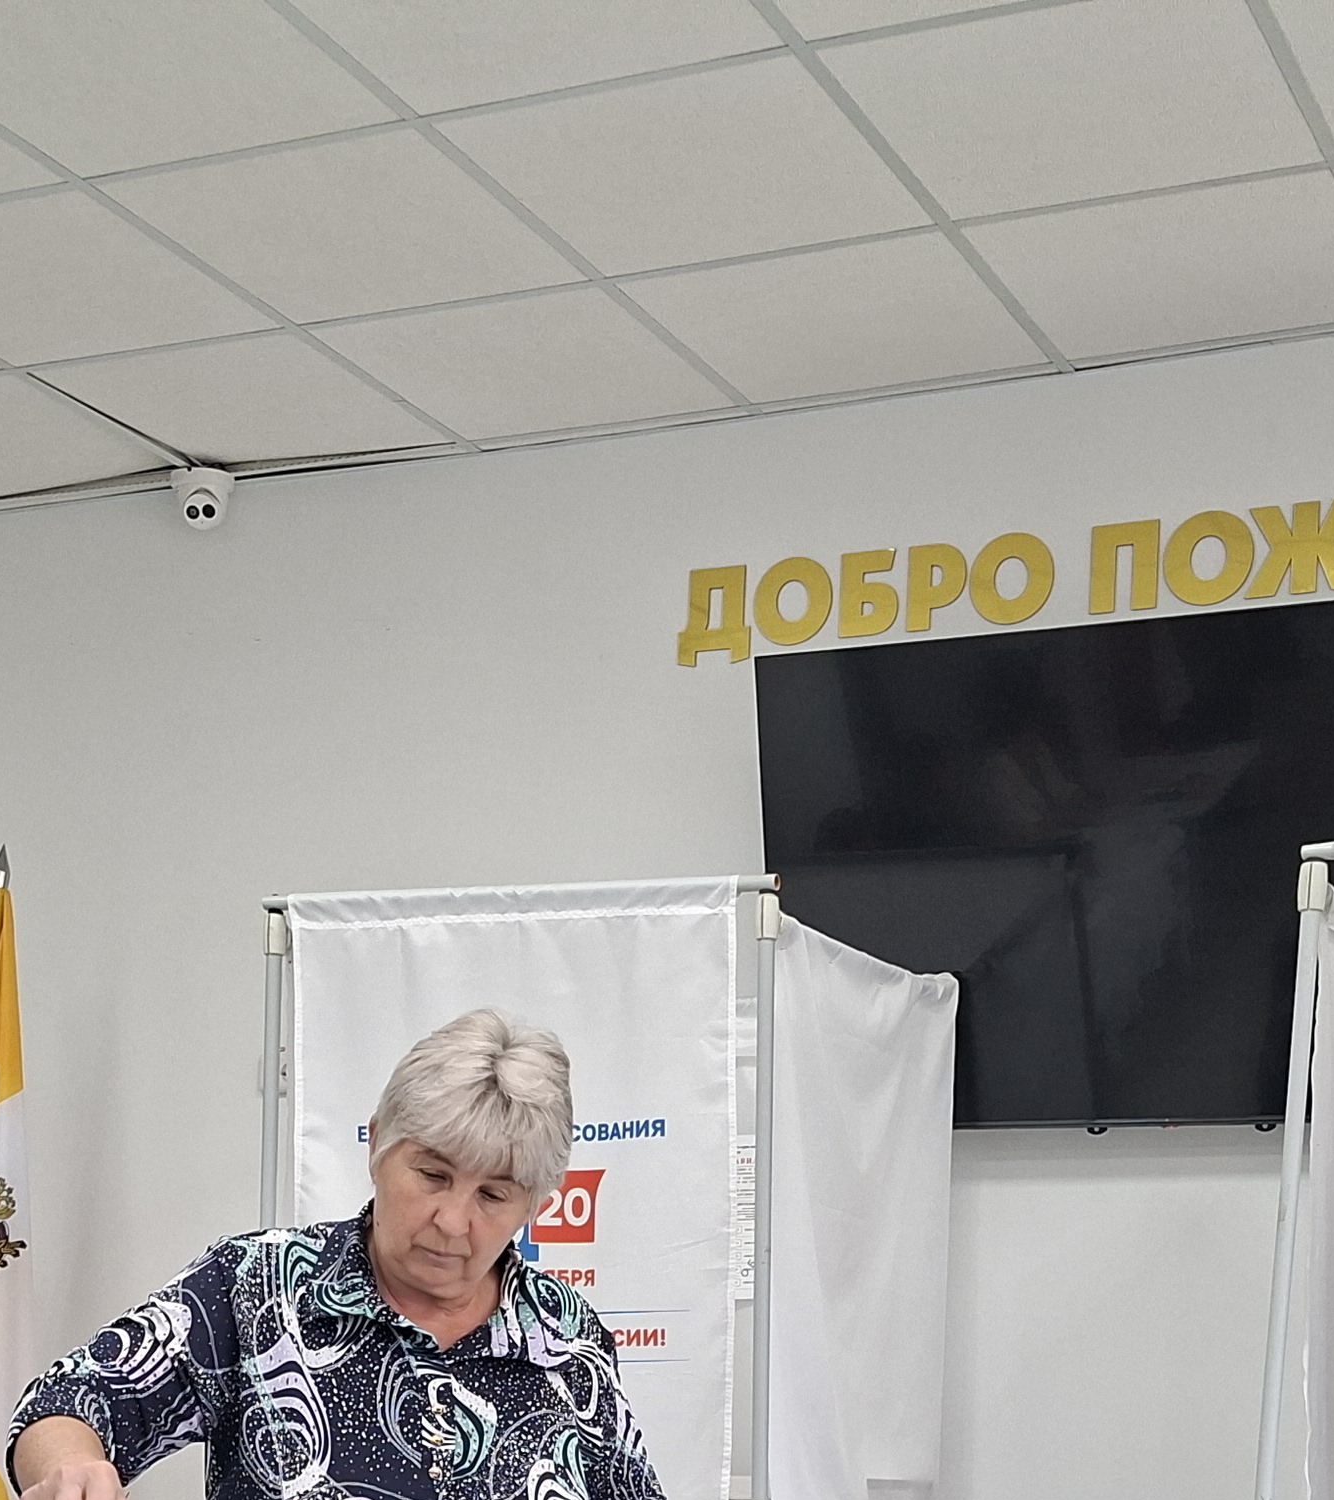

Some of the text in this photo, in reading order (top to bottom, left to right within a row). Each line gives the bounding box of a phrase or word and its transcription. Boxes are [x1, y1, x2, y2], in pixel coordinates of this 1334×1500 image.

[677, 531, 1055, 667] ДОБРО
[572, 1118, 666, 1143] СОВАНИЯ
[536, 1187, 592, 1227] 20
[612, 1328, 666, 1347] СИИ!
